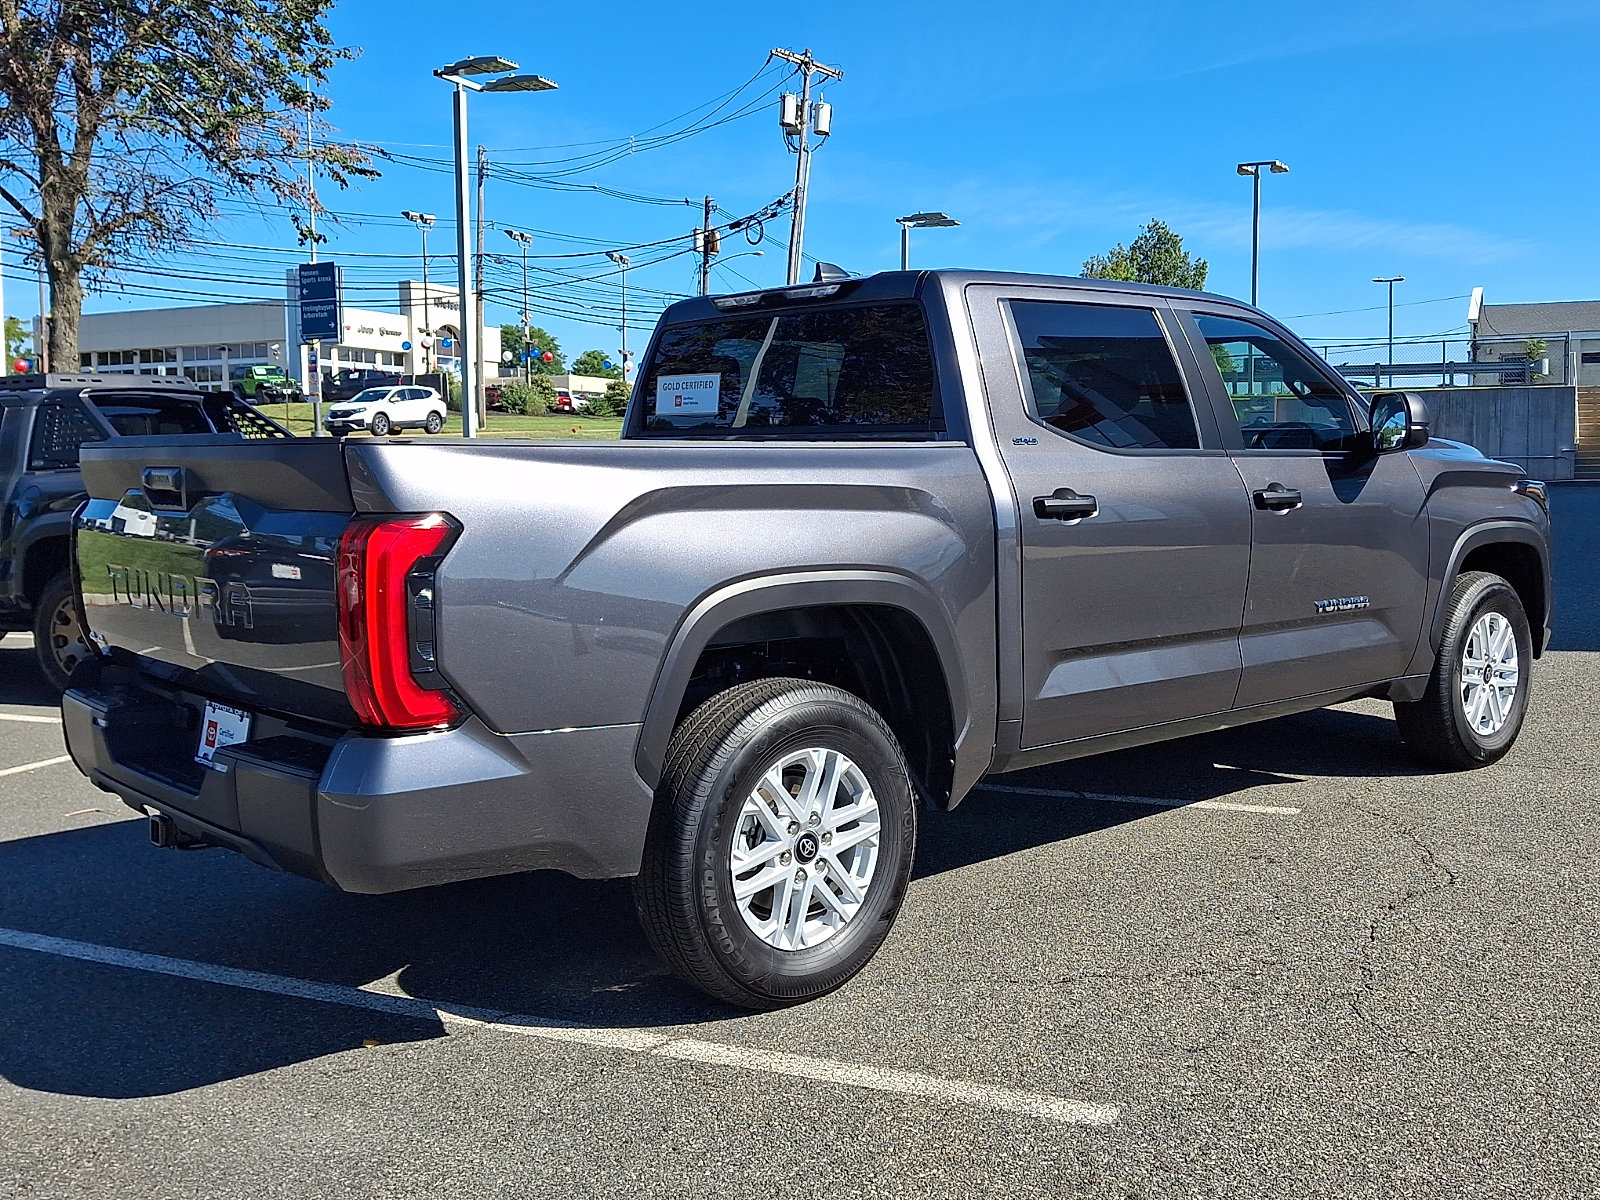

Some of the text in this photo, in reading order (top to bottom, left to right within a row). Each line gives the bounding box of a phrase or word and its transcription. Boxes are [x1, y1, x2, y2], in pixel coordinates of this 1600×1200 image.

[302, 304, 335, 313] Frelinghuysen
[303, 311, 328, 319] Arboretum
[357, 324, 374, 335] Jeep
[662, 380, 714, 391] GOLD CERTIFIED
[106, 562, 255, 630] TUNDRA
[1313, 595, 1371, 615] TUNDRA
[211, 701, 234, 714] TOYOTA
